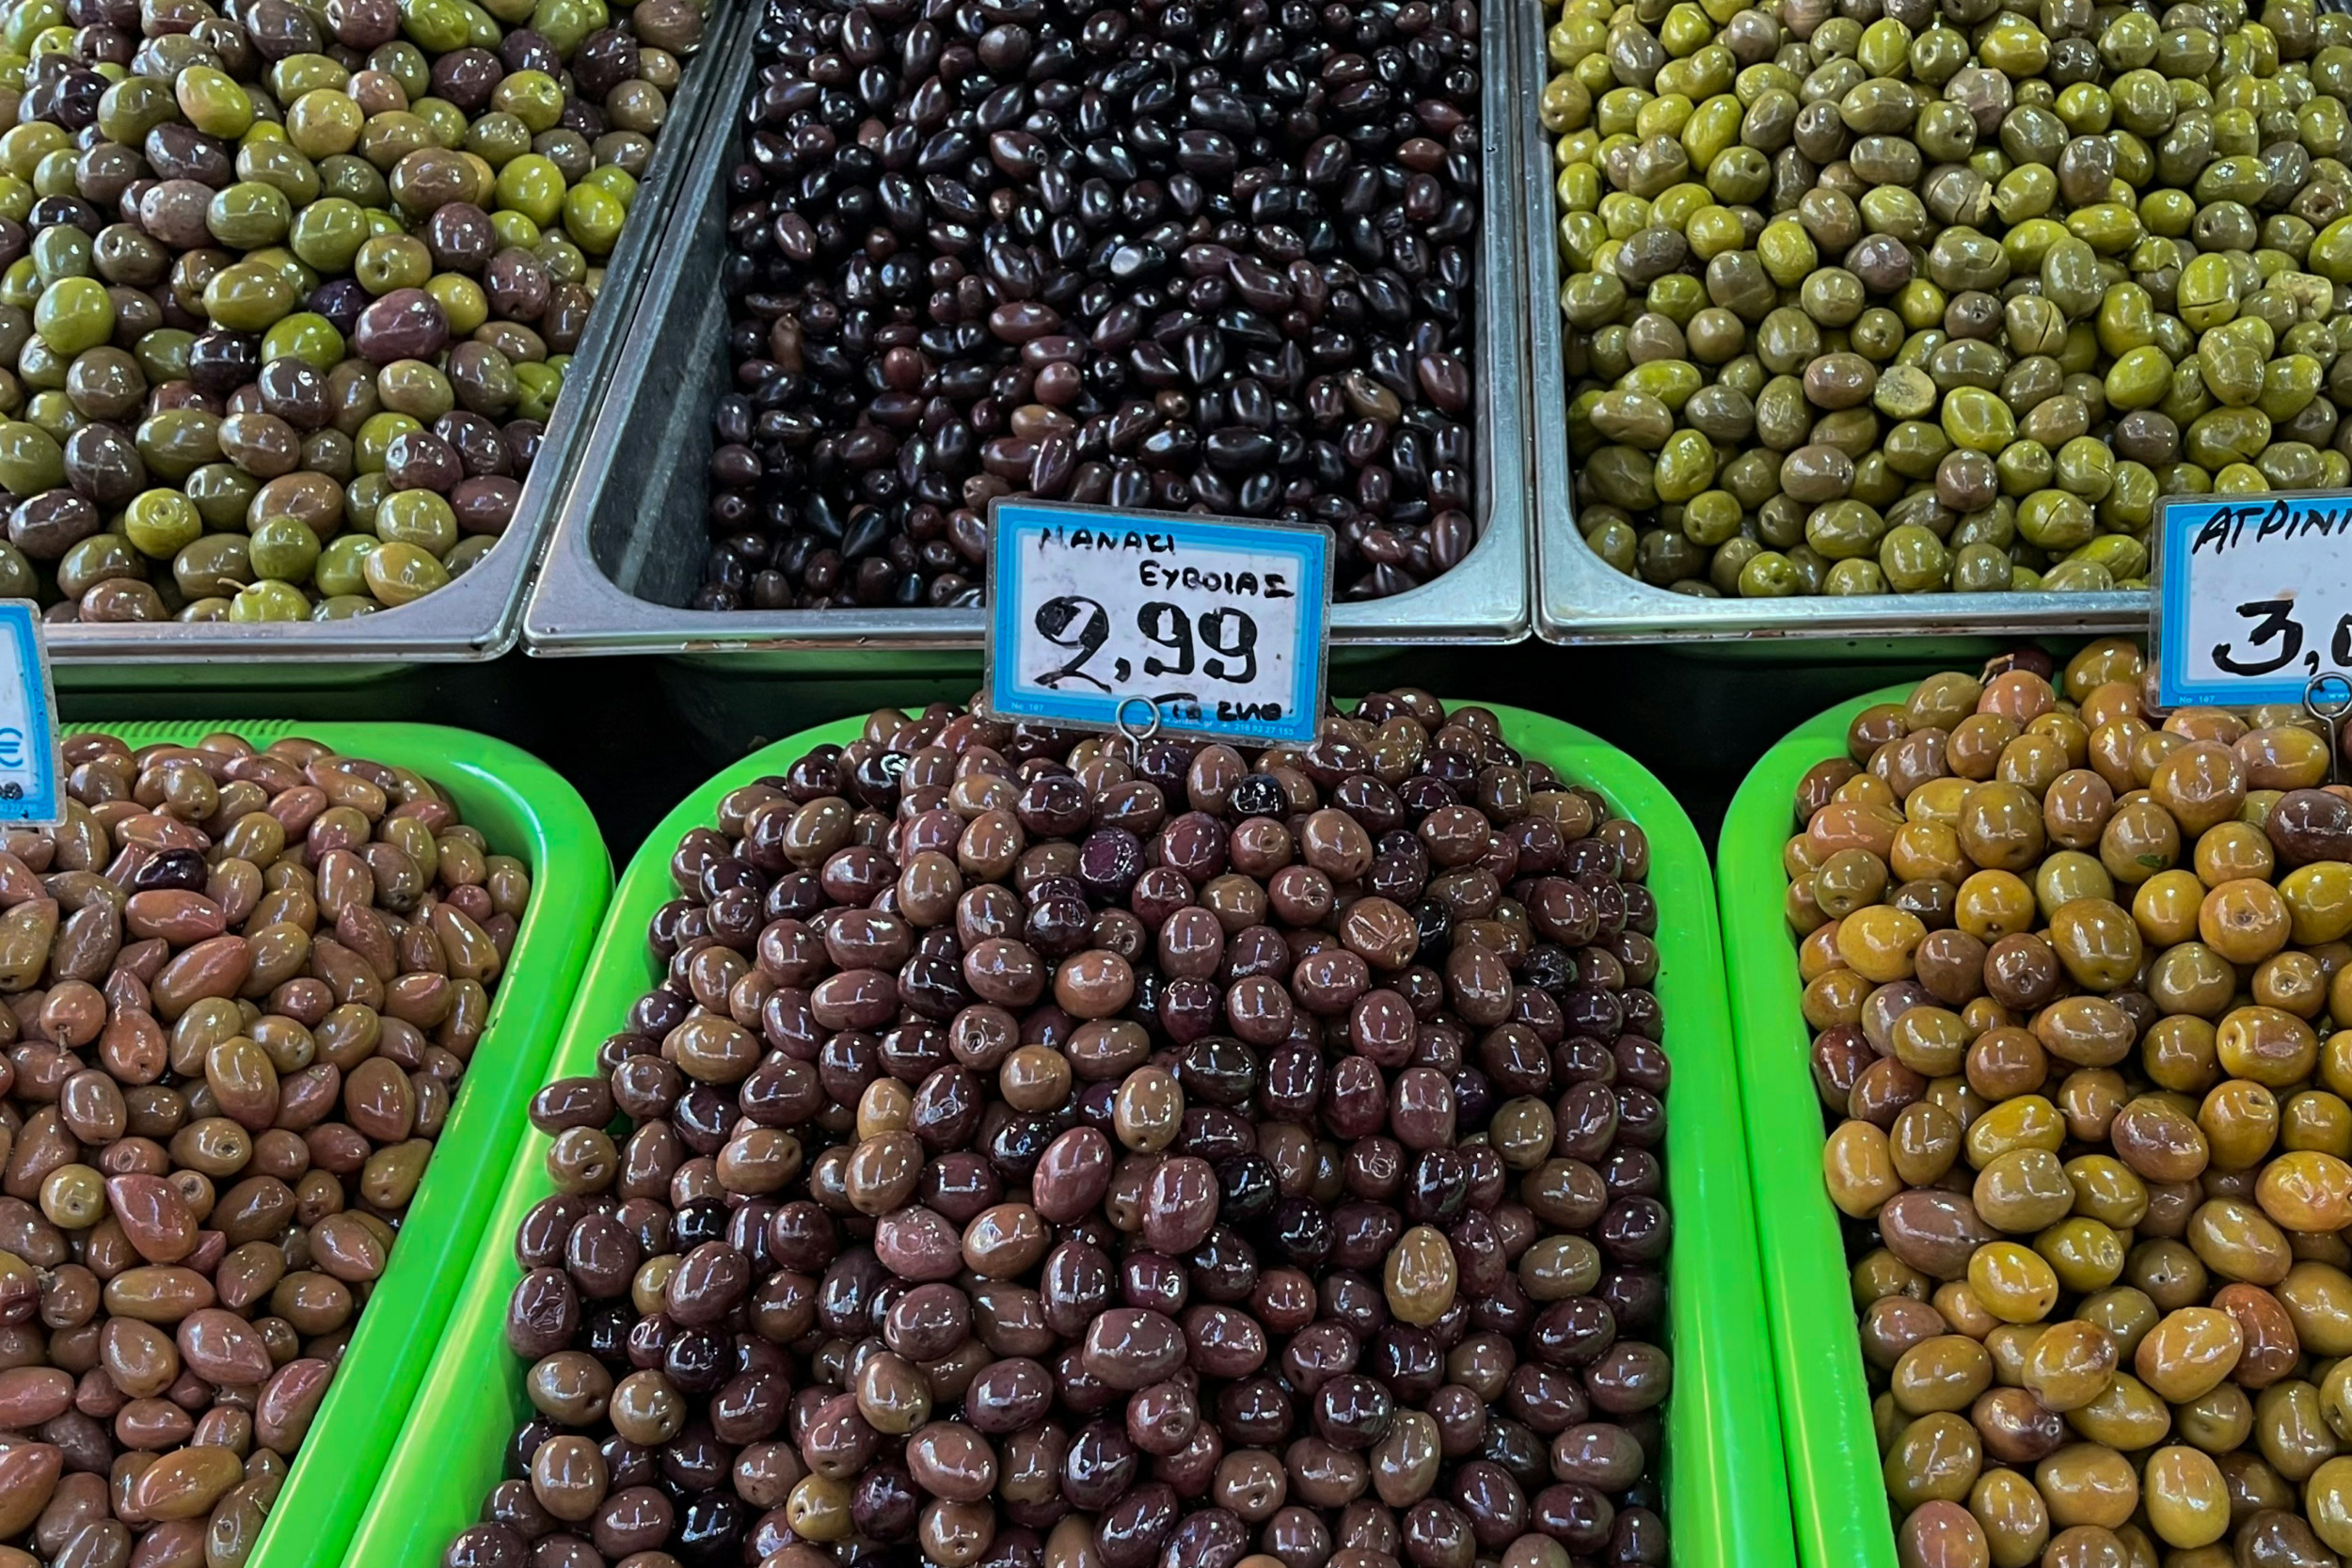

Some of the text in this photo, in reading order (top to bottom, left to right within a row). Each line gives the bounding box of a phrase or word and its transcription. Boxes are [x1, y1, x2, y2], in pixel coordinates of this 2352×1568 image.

[1139, 559, 1295, 598] ΕΥΒΟΙΑΣ
[1034, 595, 1257, 694] 2,99
[0, 727, 24, 767] €
